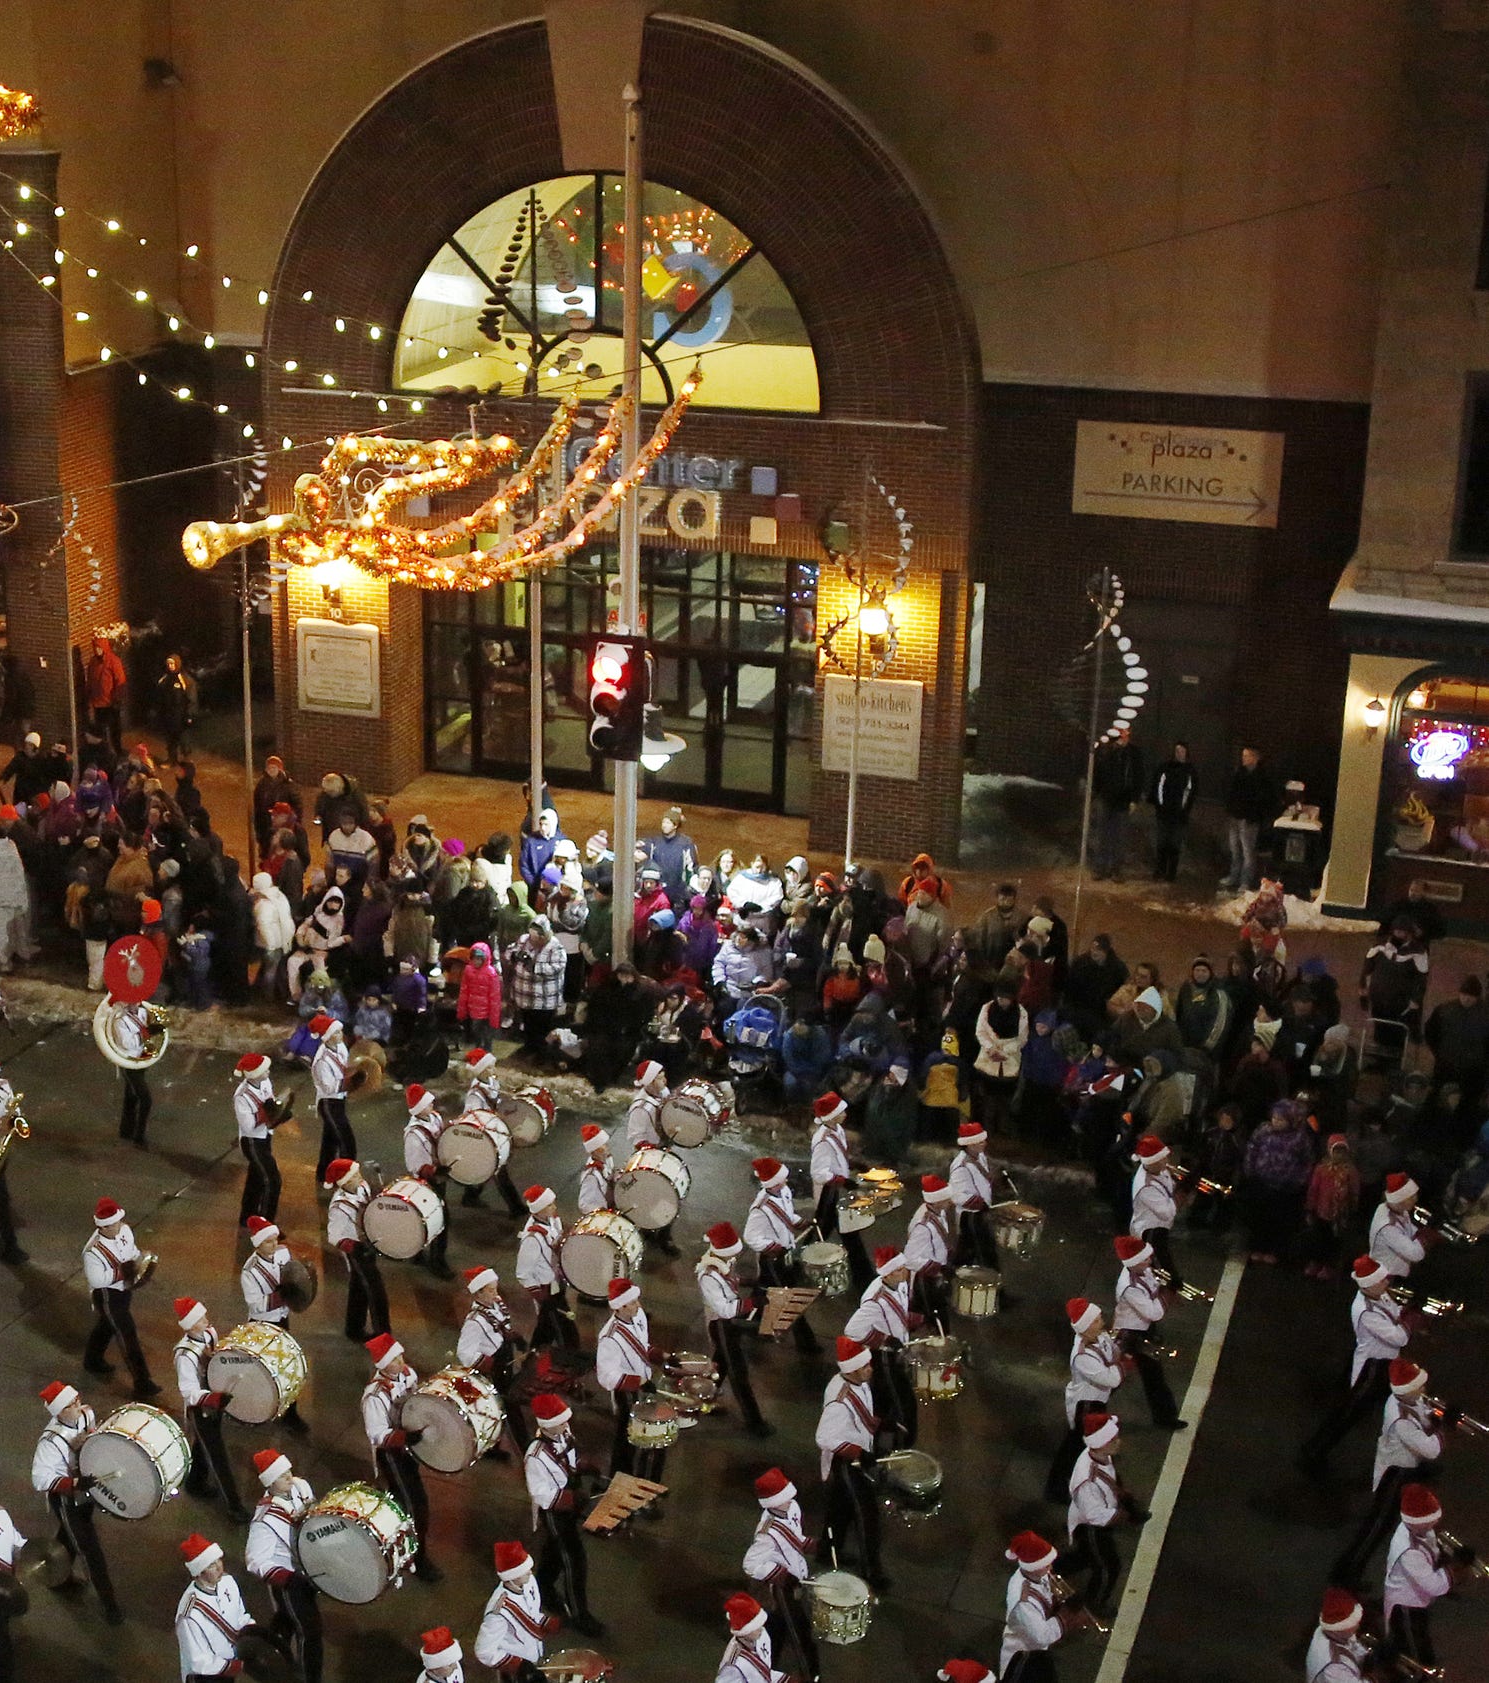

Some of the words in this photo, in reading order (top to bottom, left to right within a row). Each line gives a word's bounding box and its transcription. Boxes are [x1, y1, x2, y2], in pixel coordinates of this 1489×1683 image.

[1150, 431, 1212, 467] plaza
[1121, 473, 1224, 497] PARKING
[329, 607, 342, 618] 10
[385, 1203, 408, 1211] YAMAHA
[314, 1520, 348, 1539] YAMAHA
